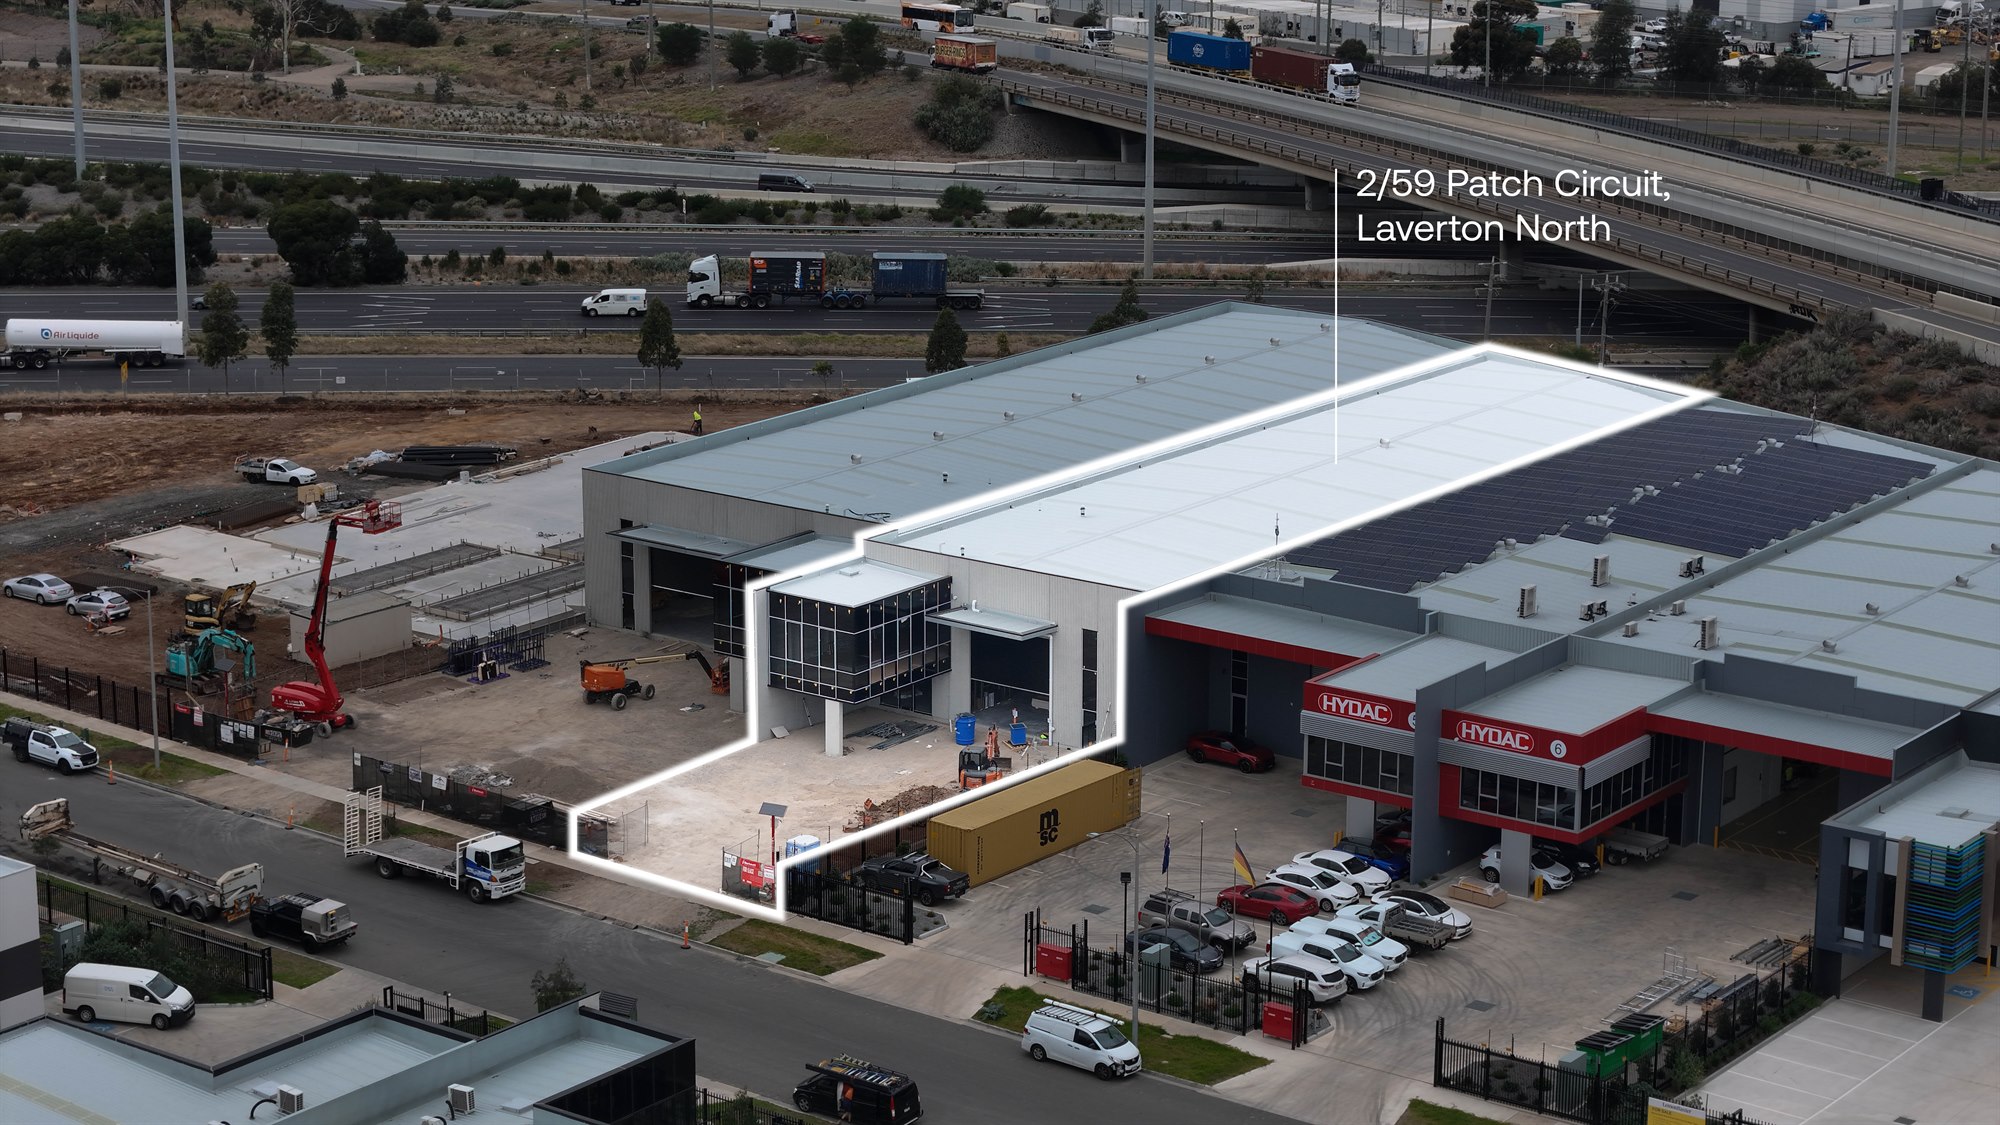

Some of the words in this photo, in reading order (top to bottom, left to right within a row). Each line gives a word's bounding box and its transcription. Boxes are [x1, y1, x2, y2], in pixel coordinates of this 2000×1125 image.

[53, 331, 66, 339] Air
[67, 331, 99, 340] Liquide
[1322, 694, 1389, 723] HYDAC
[1461, 722, 1530, 751] HYDAC
[1555, 743, 1562, 755] 6
